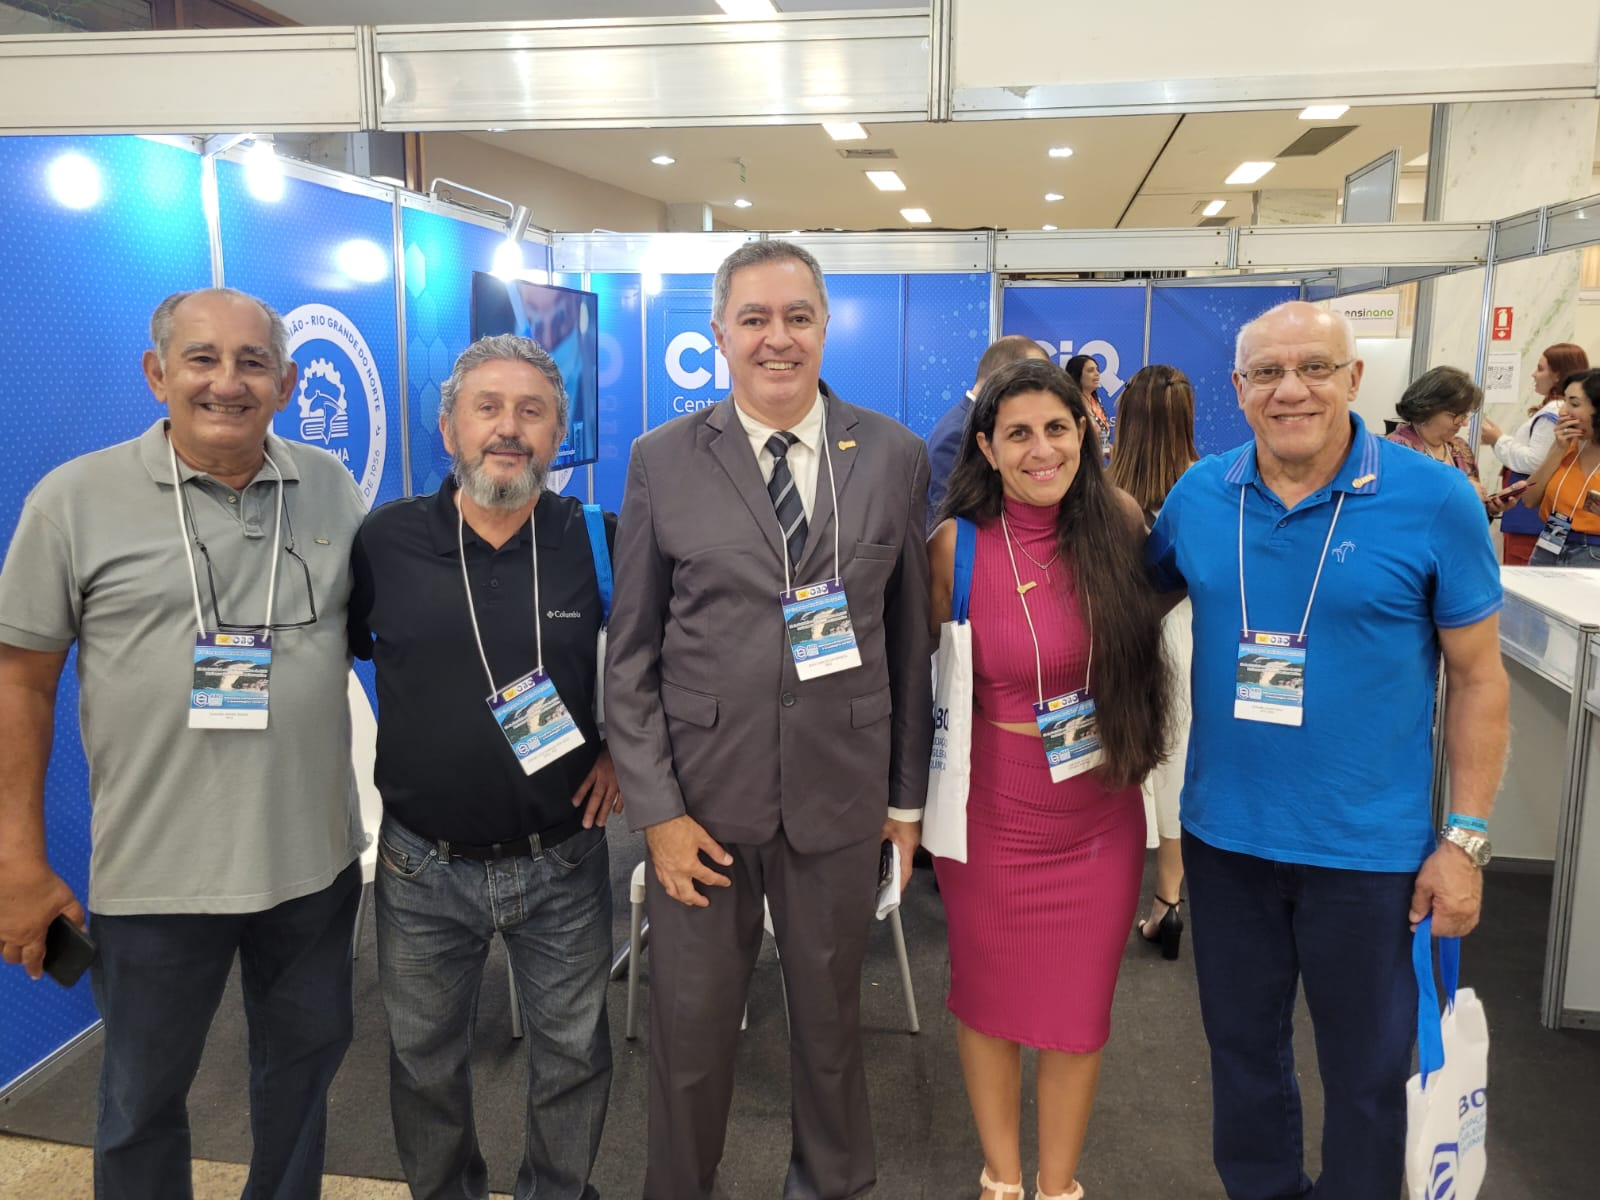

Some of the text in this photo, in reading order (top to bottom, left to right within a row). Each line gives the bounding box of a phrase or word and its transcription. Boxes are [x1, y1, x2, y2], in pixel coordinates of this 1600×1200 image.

[311, 315, 326, 326] RIO
[327, 318, 359, 351] GRANDE
[358, 349, 368, 367] DO
[366, 368, 381, 412] NORTE
[665, 331, 730, 390] Ci
[1034, 340, 1125, 398] iQ
[363, 480, 374, 498] DE
[554, 610, 581, 618] Columbia
